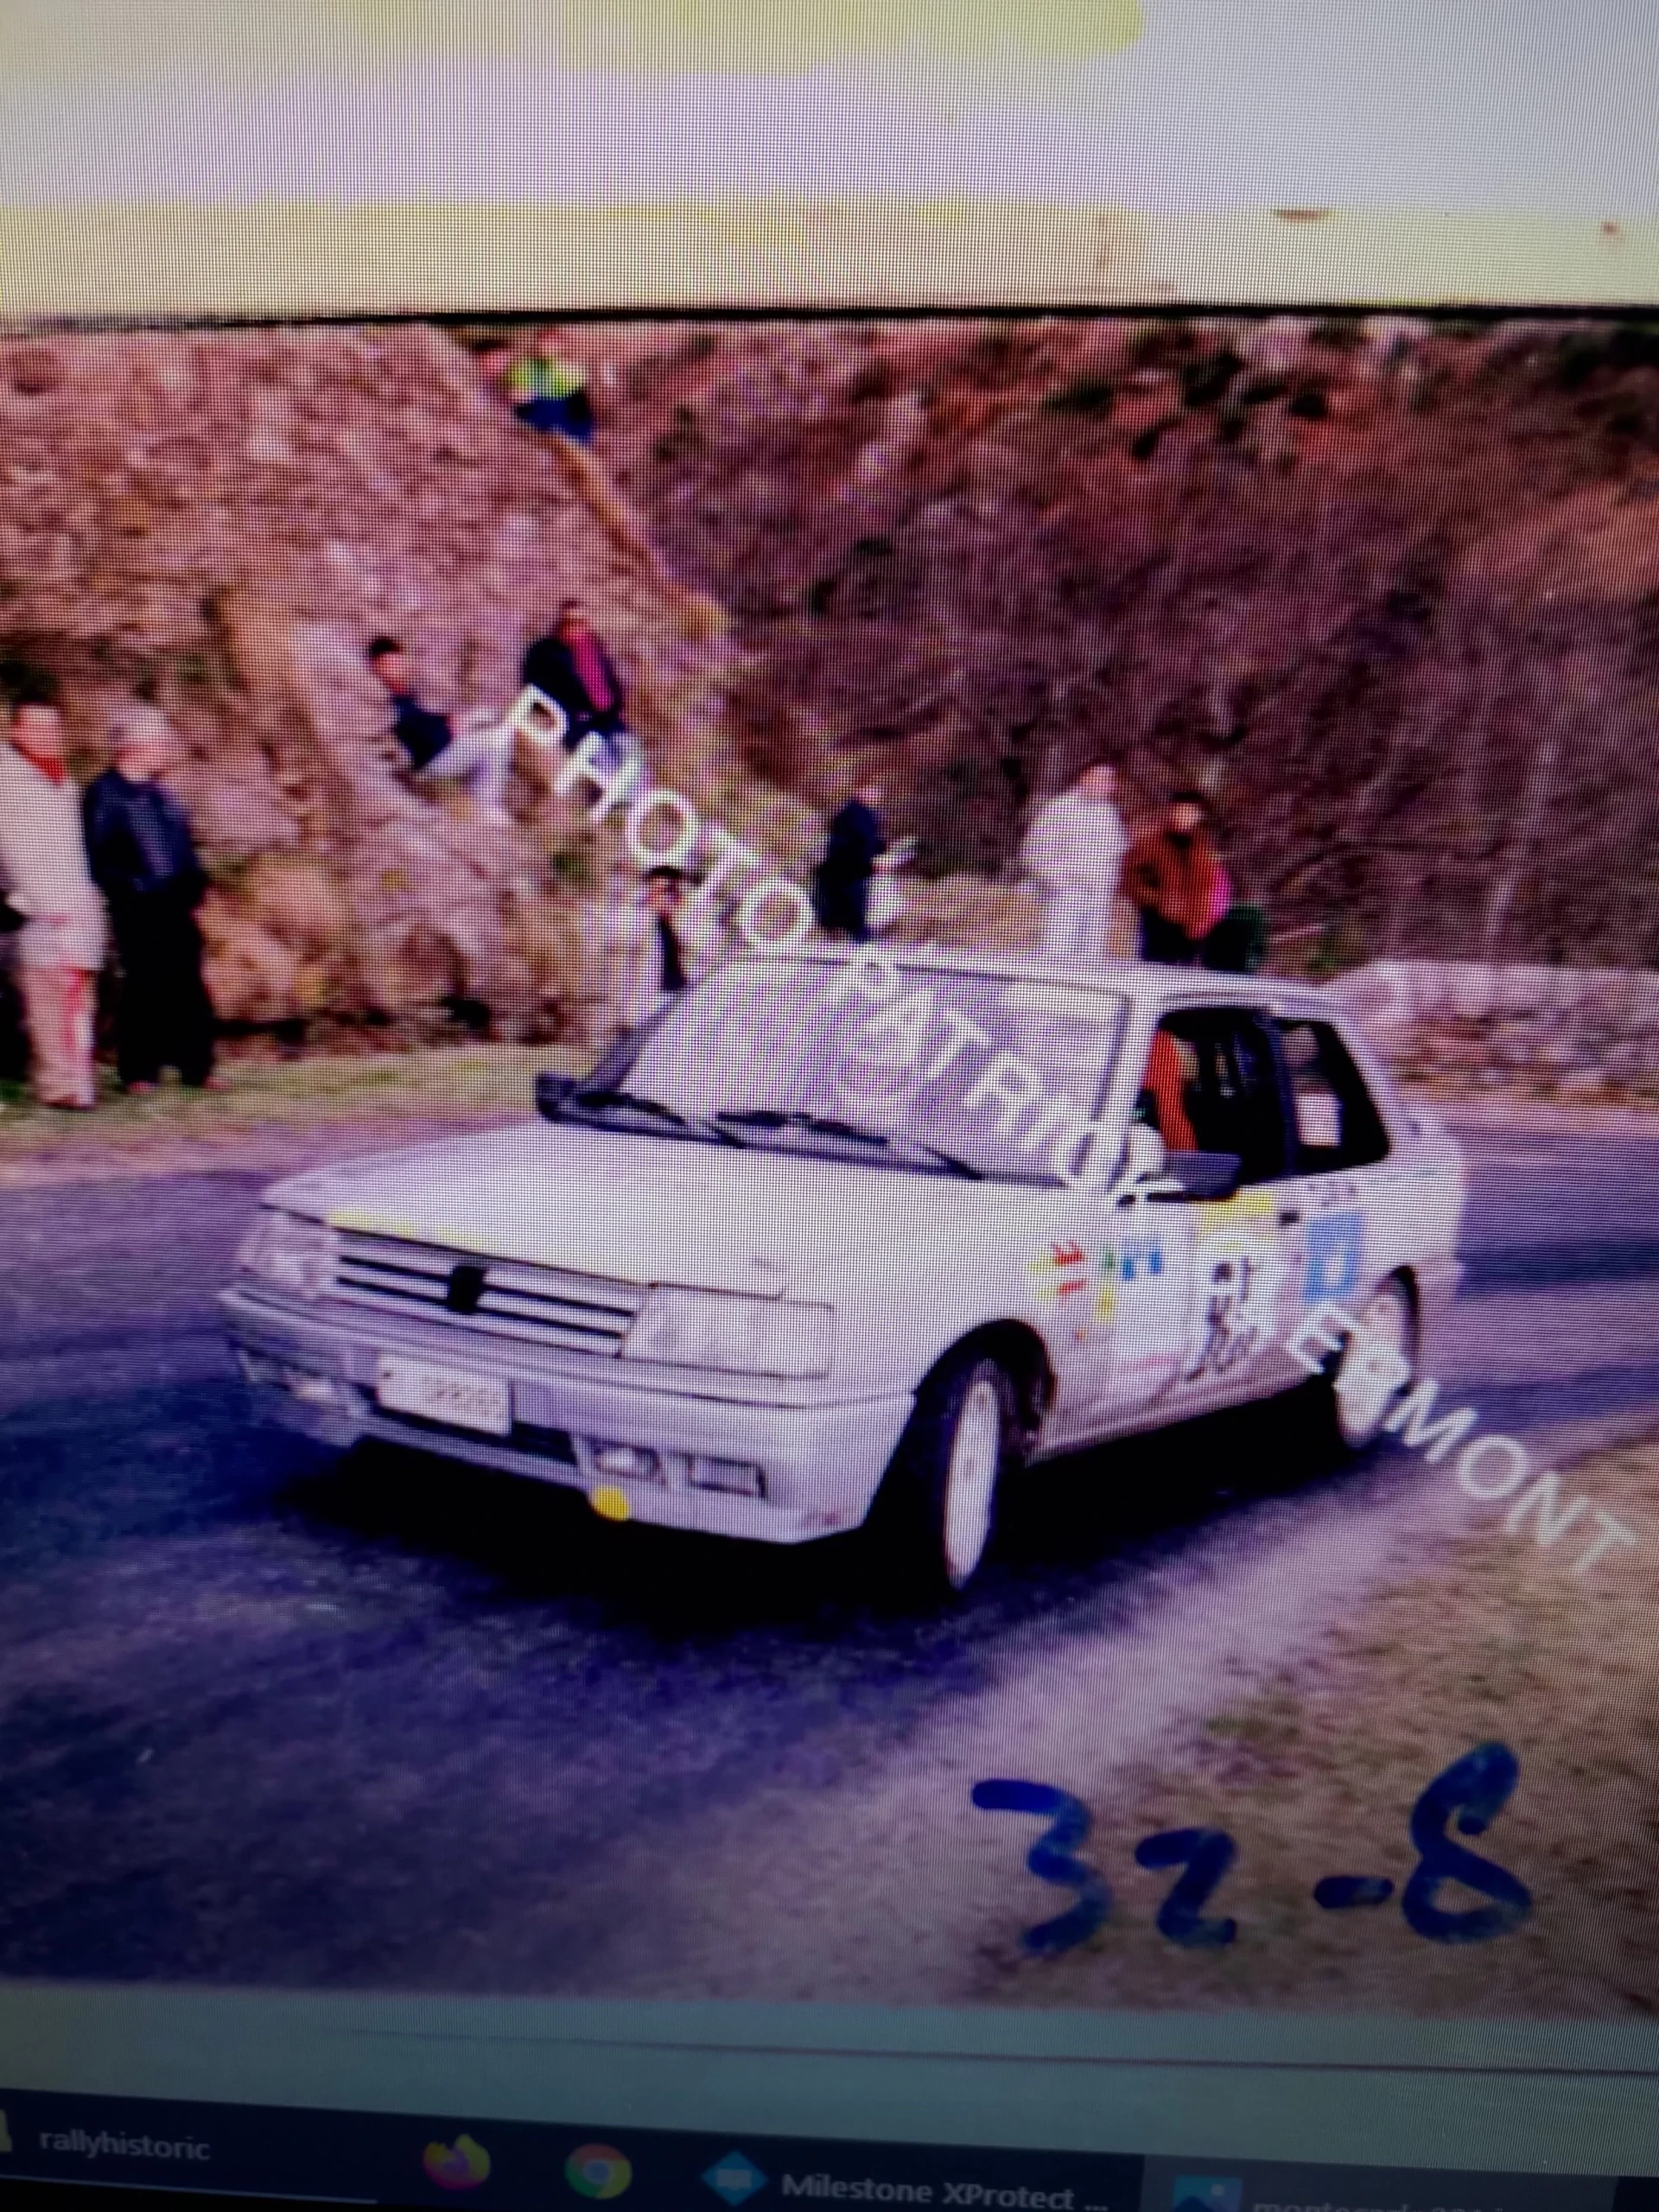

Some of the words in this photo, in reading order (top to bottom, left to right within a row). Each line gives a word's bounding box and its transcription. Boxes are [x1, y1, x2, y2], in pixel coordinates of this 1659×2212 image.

[39, 2127, 211, 2161] rallyhistoric
[782, 2173, 932, 2203] Milestone
[942, 2182, 1076, 2211] XProtect
